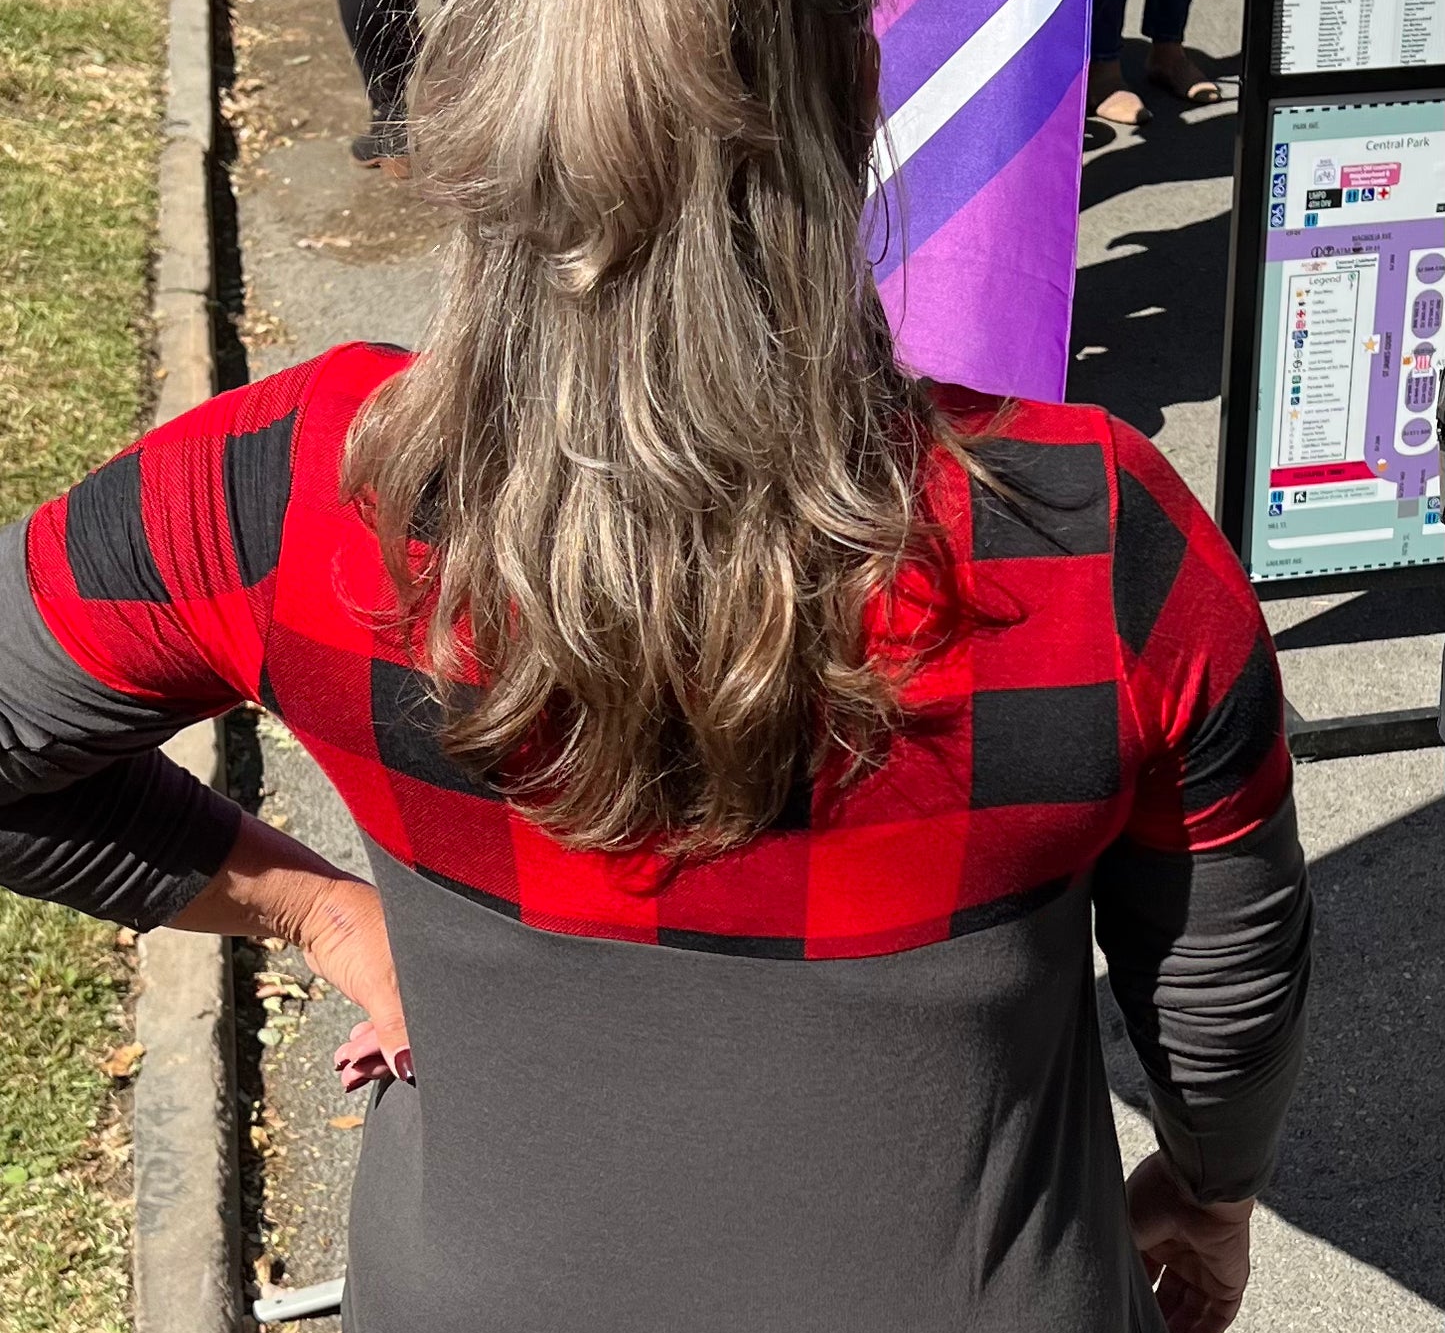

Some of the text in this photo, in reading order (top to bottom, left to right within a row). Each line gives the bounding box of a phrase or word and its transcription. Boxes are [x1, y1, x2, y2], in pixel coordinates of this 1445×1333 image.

[1366, 136, 1430, 151] Central Park
[1309, 275, 1342, 286] Legend
